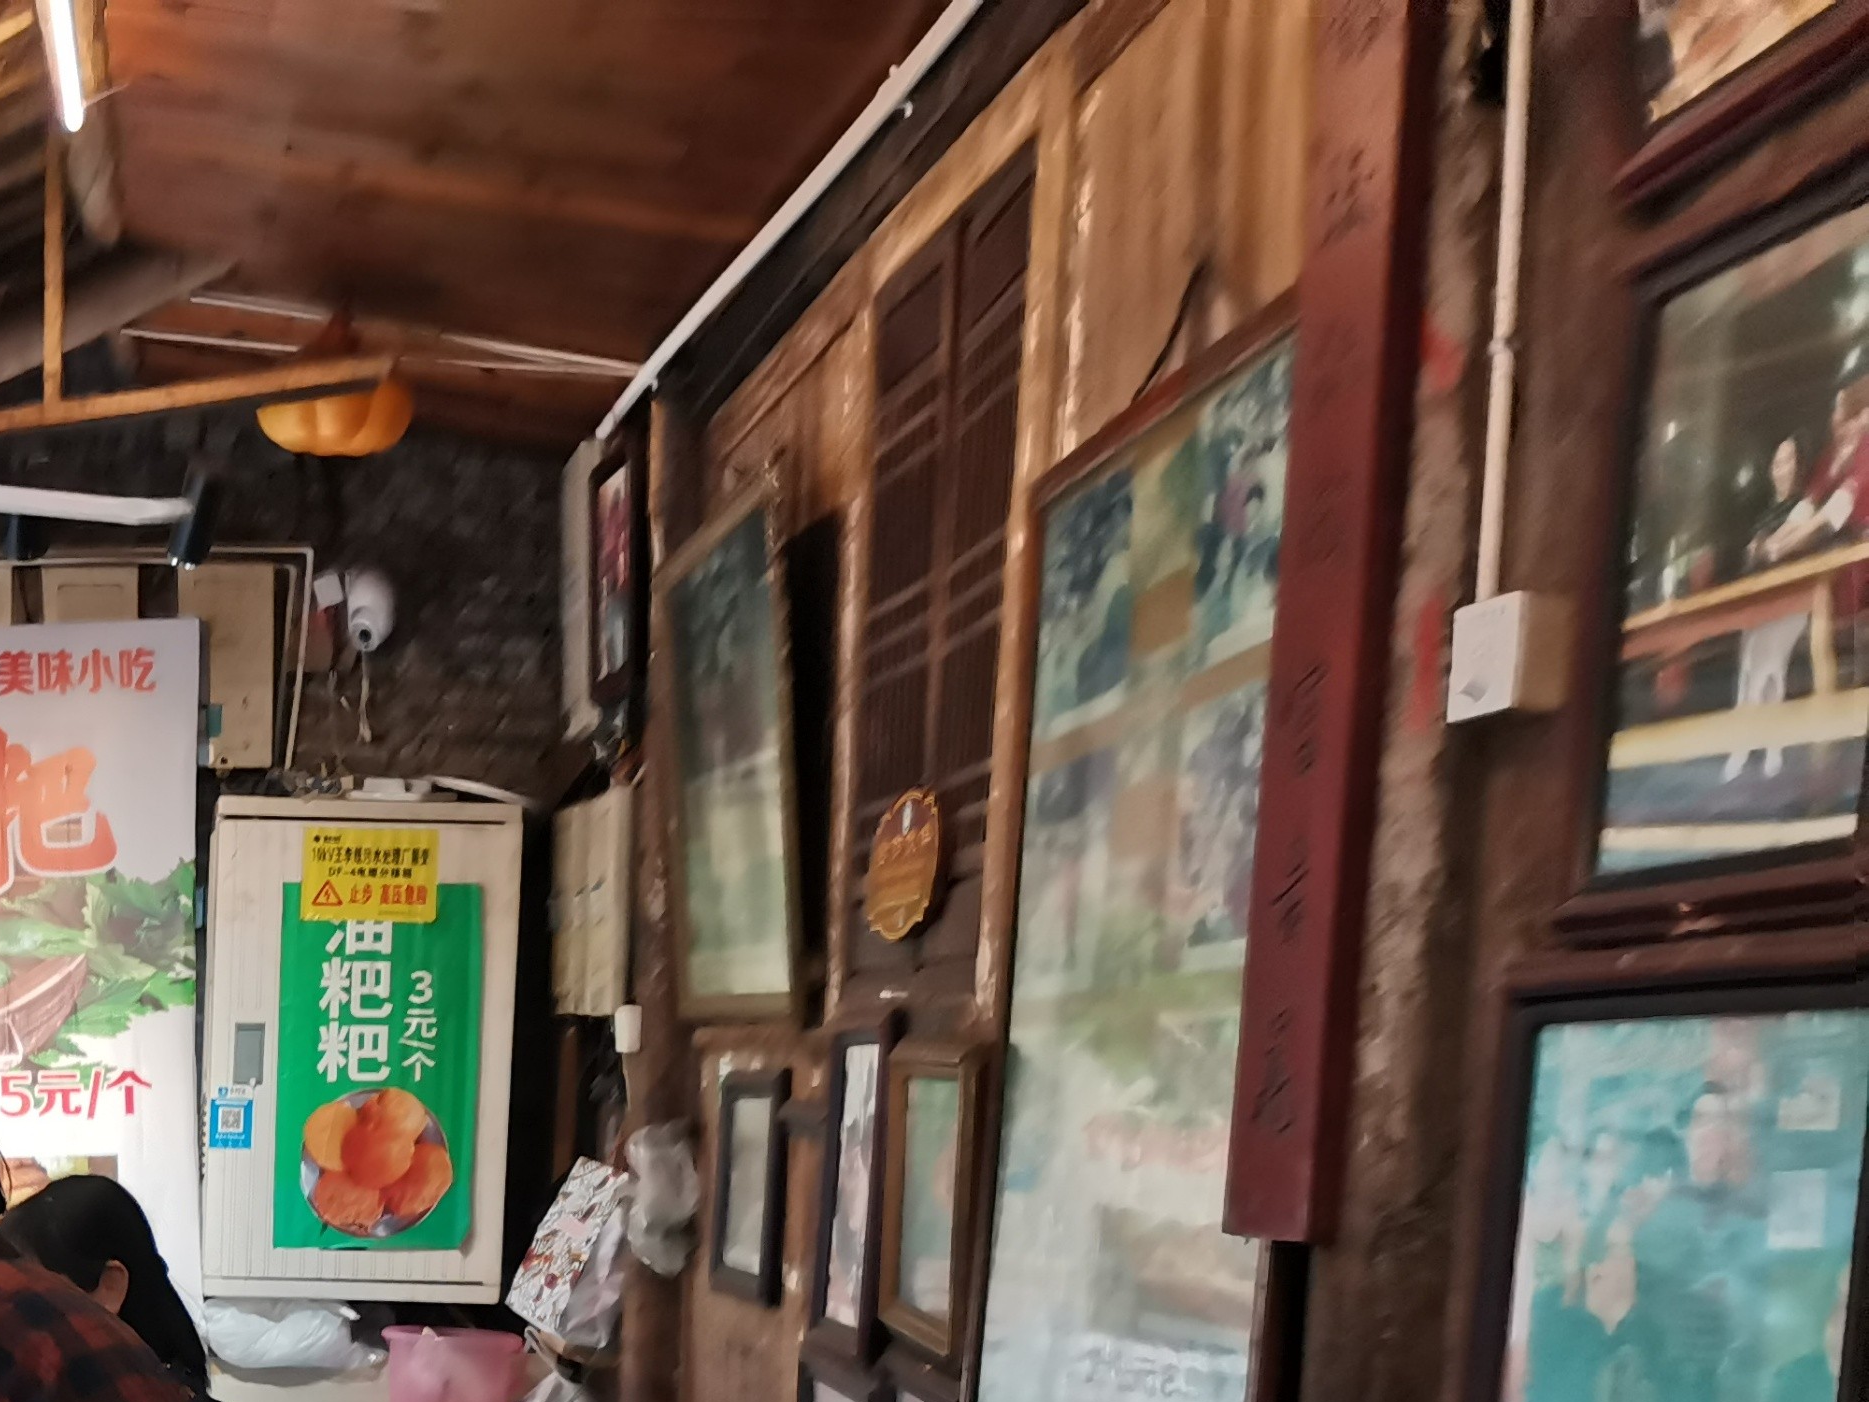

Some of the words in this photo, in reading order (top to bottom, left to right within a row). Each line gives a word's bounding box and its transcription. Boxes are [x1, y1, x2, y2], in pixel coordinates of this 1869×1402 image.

[316, 920, 394, 1083] 油粑粑
[398, 970, 439, 1082] 3元/个
